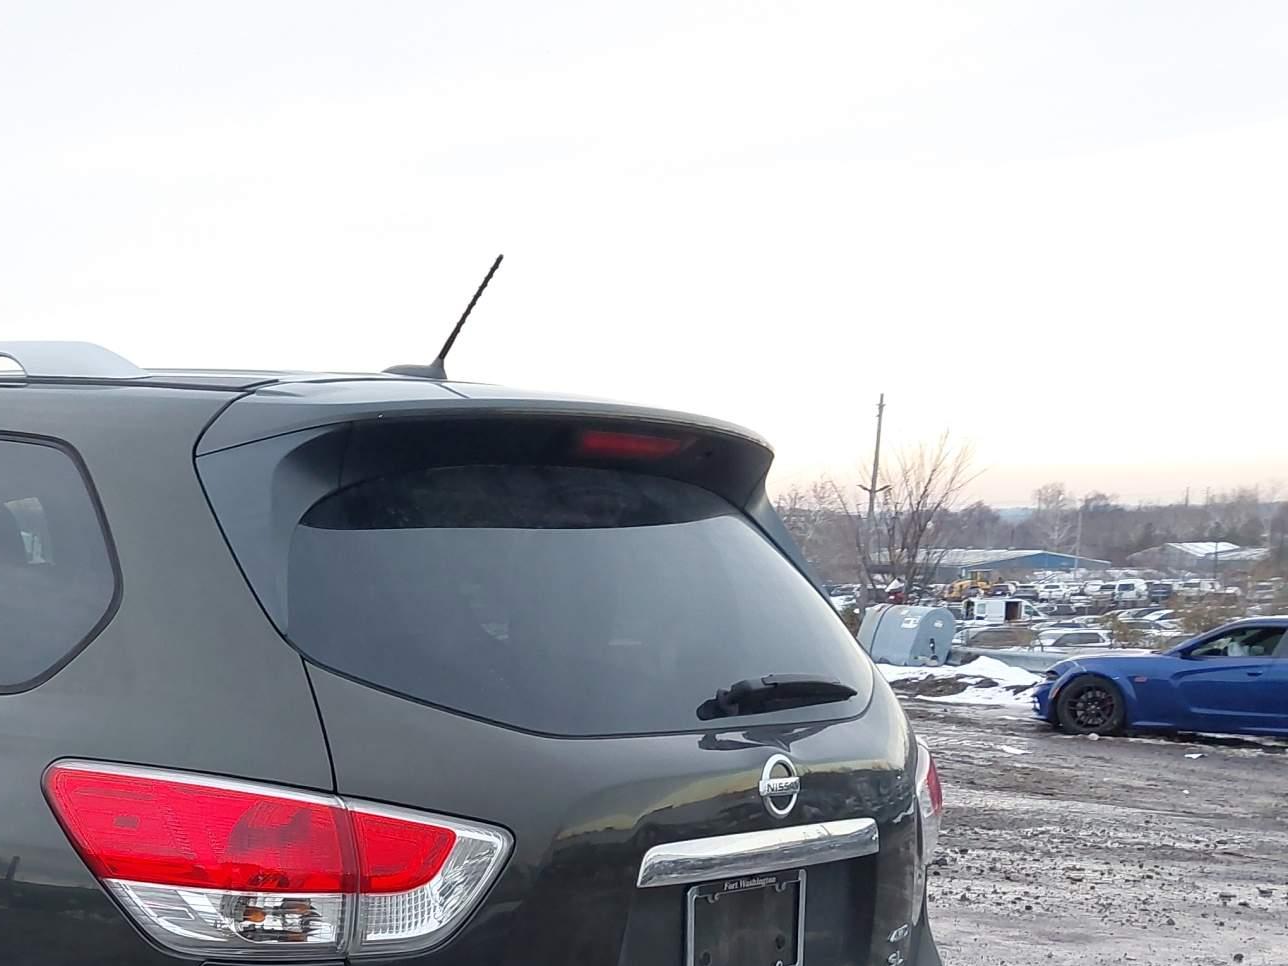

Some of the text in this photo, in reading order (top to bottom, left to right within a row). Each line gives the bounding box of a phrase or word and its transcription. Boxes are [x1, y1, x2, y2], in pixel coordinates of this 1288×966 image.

[767, 781, 799, 793] NISSAN
[723, 876, 777, 891] Fort Washington
